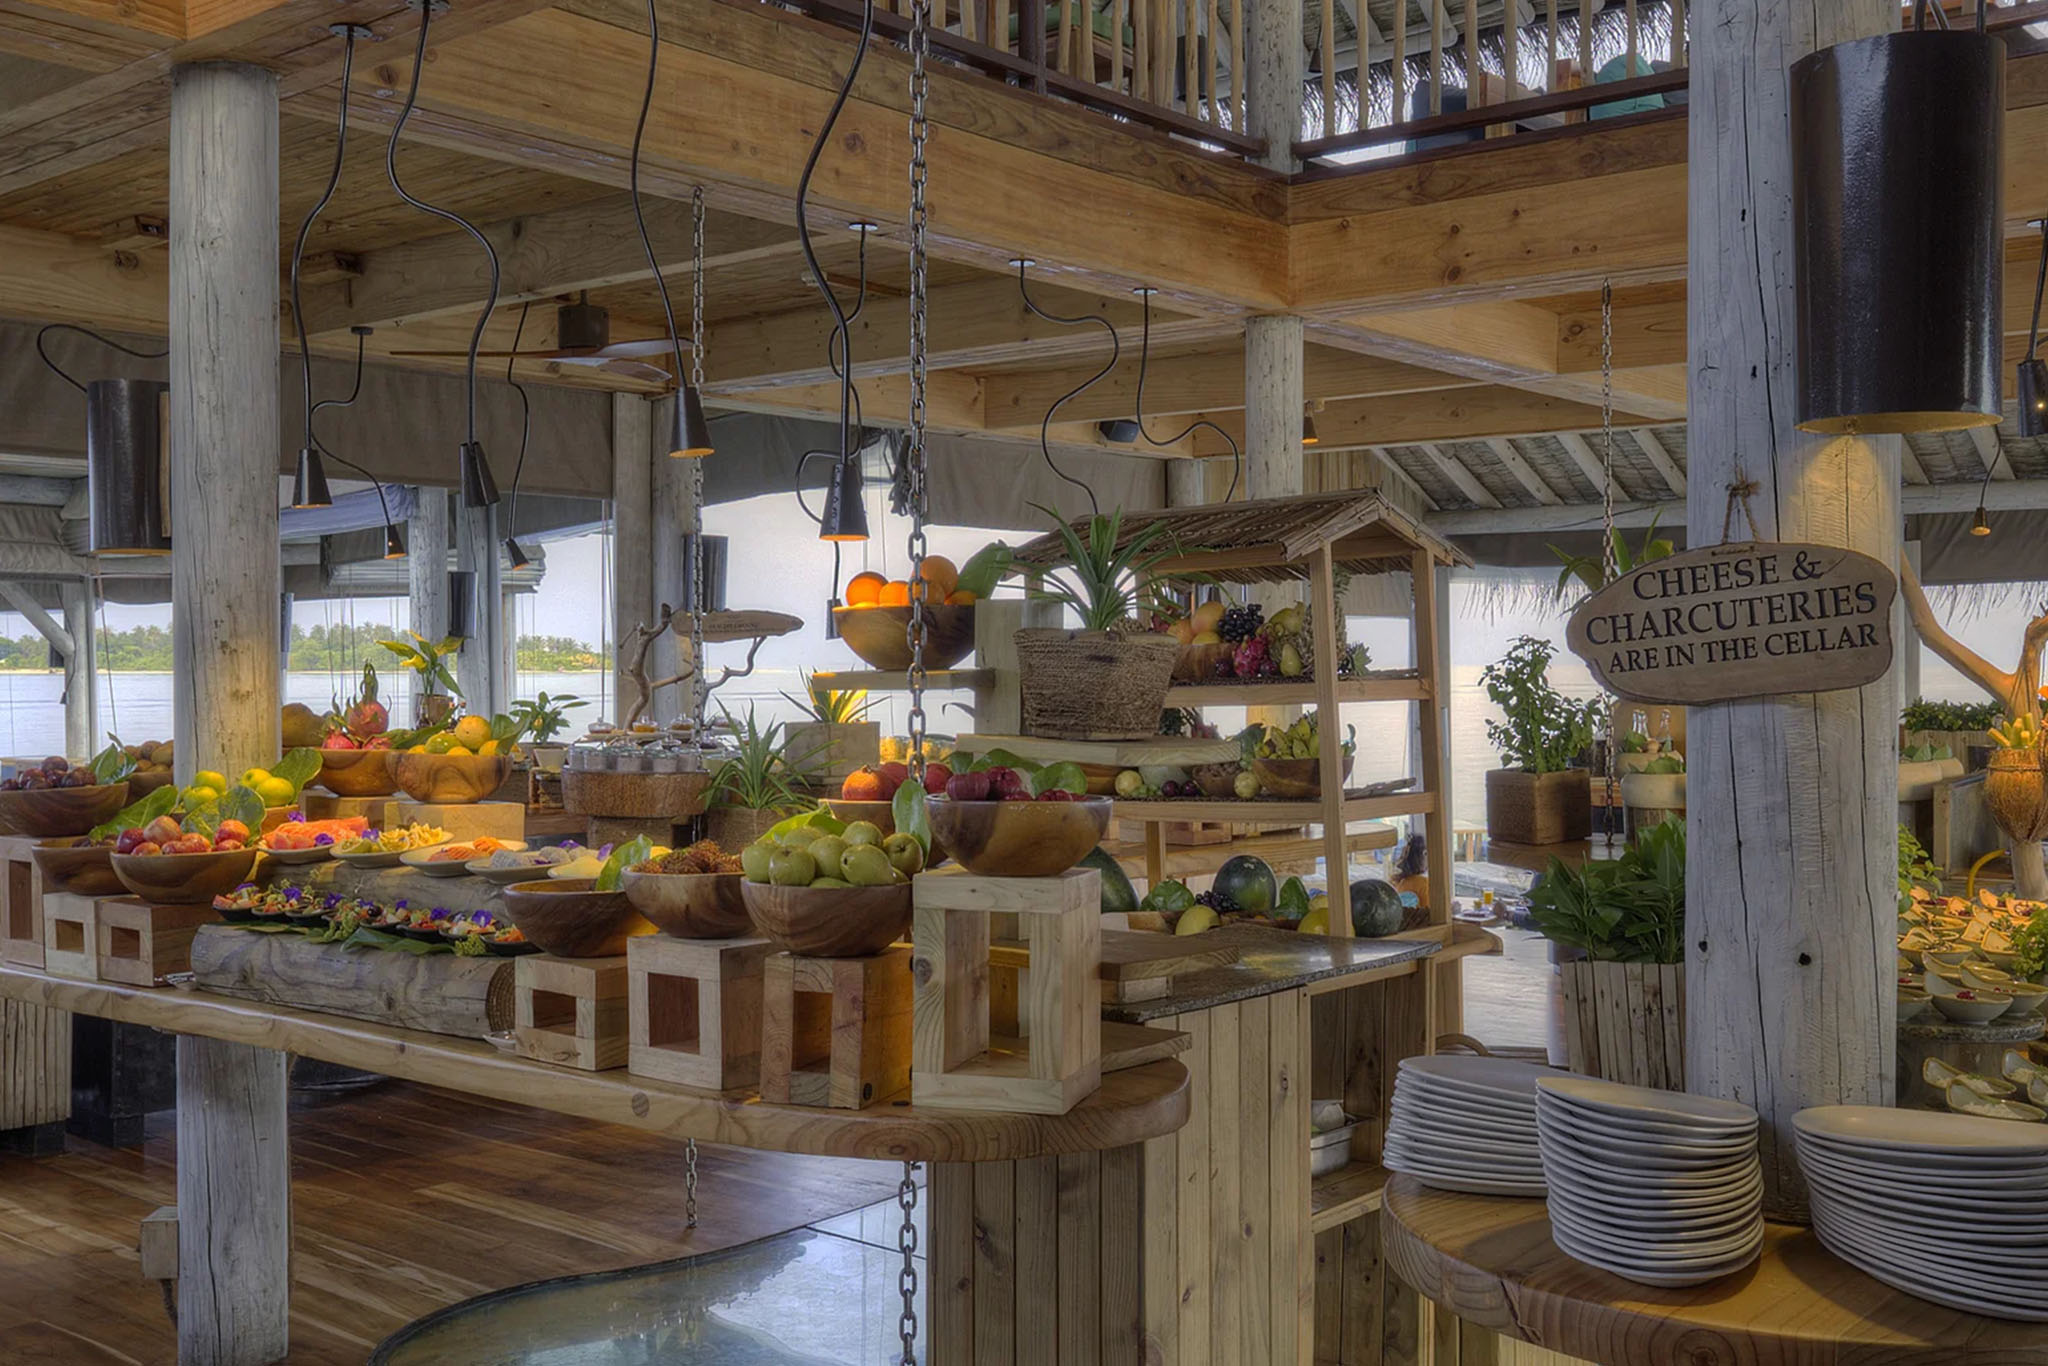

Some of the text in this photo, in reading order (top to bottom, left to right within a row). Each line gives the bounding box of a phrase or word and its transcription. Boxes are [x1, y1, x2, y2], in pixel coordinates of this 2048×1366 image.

[1633, 550, 1825, 600] CHEESE &
[1586, 582, 1877, 645] CHARCUTERIES
[1609, 623, 1879, 673] ARE IN THE CELLAR
